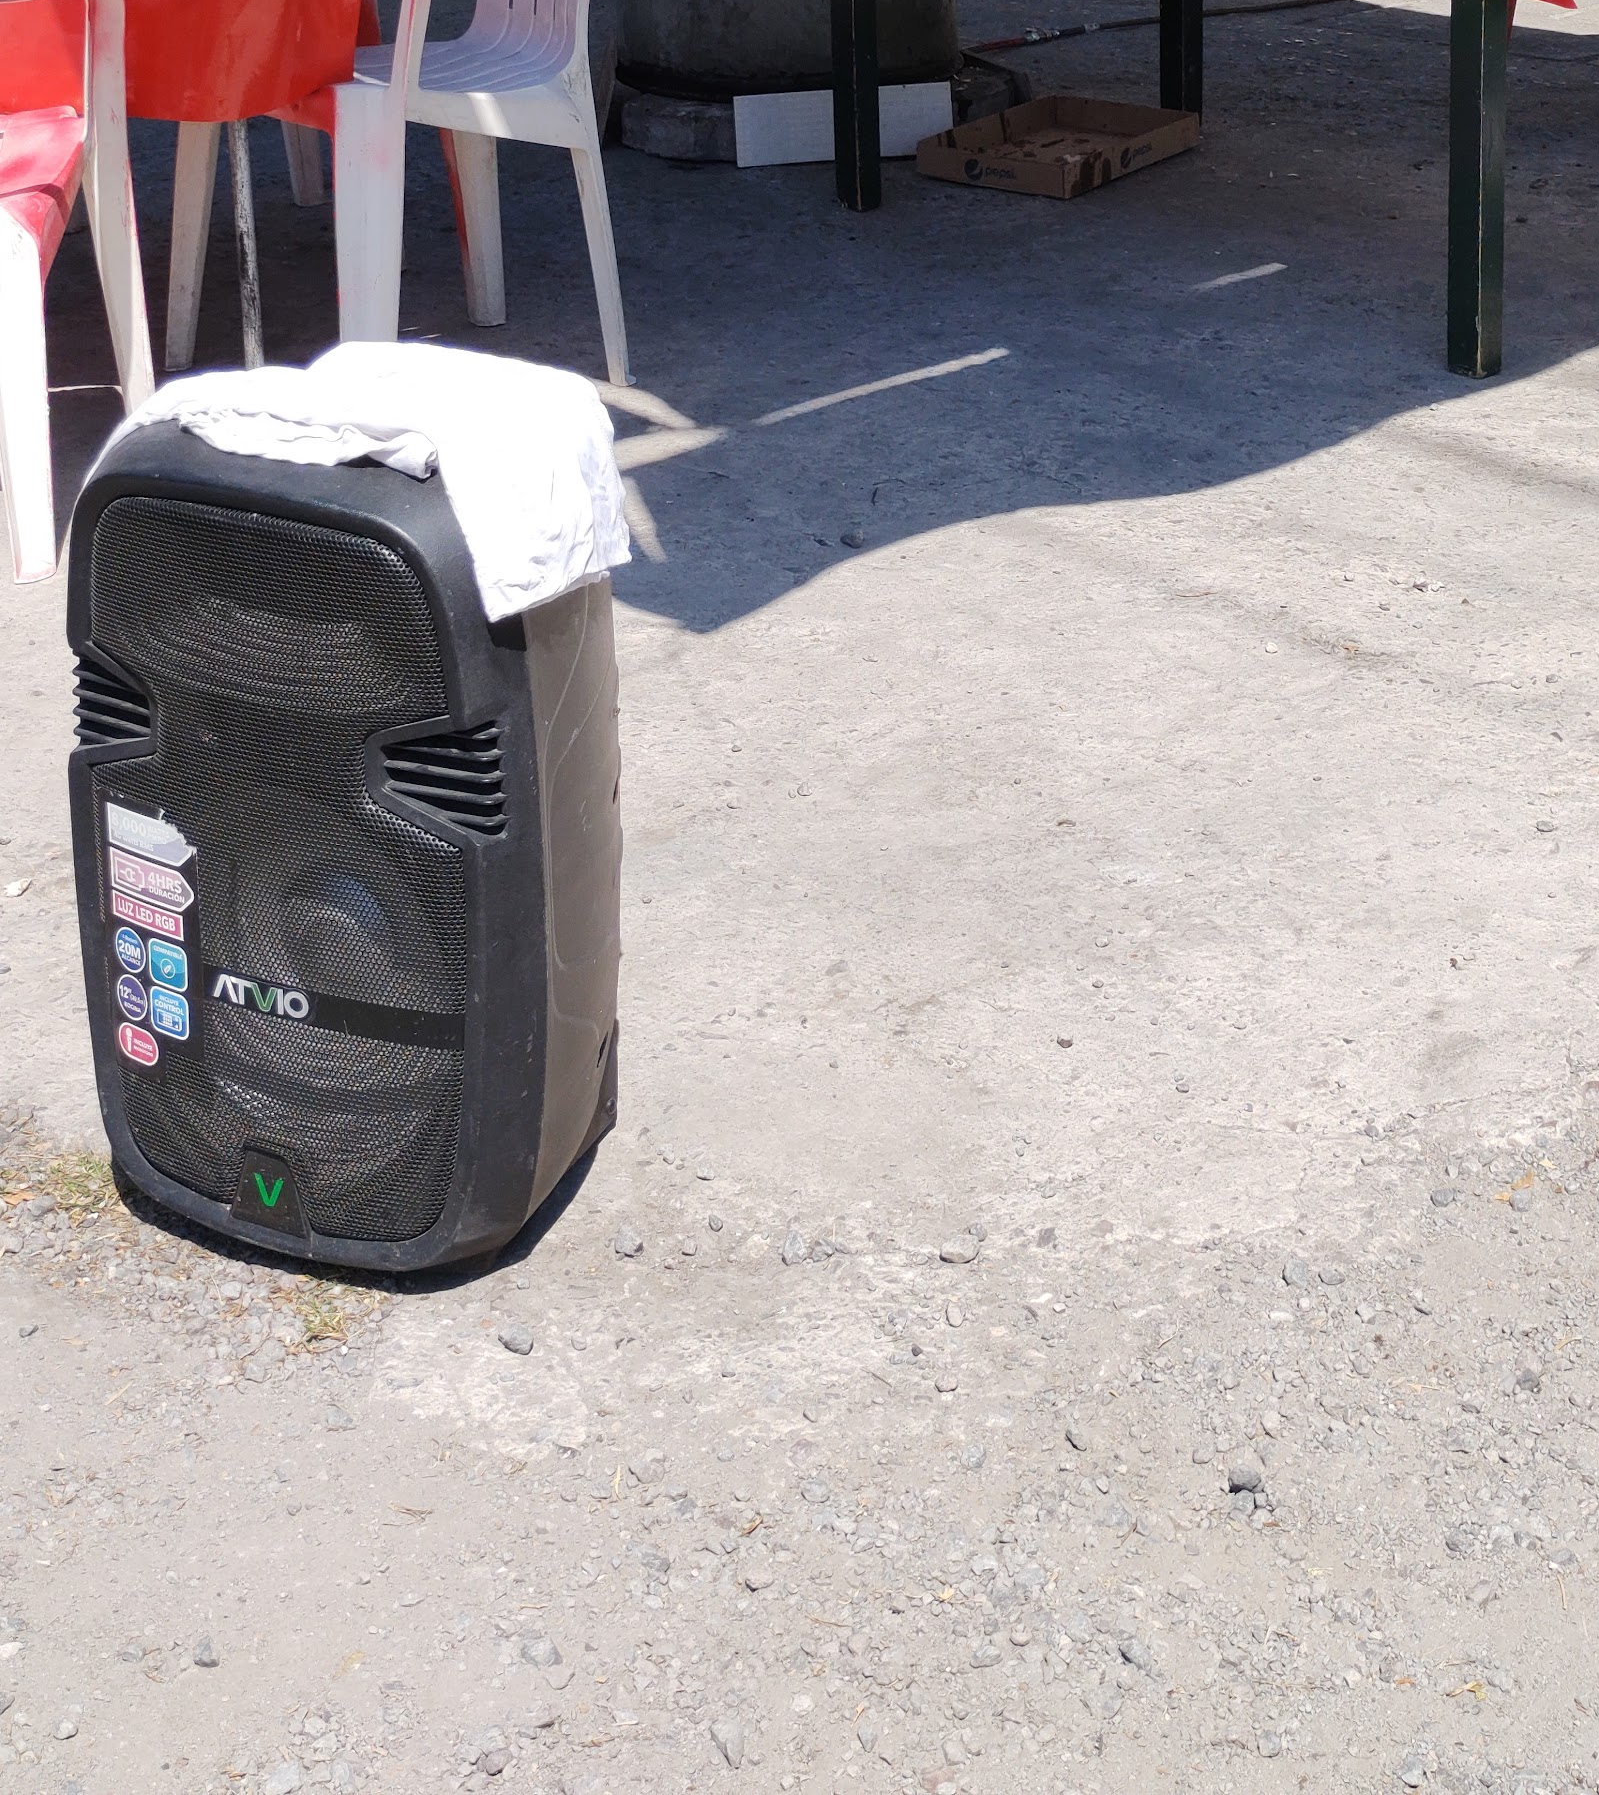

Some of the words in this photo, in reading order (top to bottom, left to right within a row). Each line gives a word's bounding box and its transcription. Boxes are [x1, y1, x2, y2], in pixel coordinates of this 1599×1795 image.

[147, 871, 184, 894] 4HRS
[117, 897, 135, 916] LUZ
[135, 905, 154, 924] LED
[155, 914, 176, 932] RGB
[118, 939, 141, 960] 20M
[154, 999, 184, 1016] CONTROL
[214, 974, 309, 1018] ATVIO
